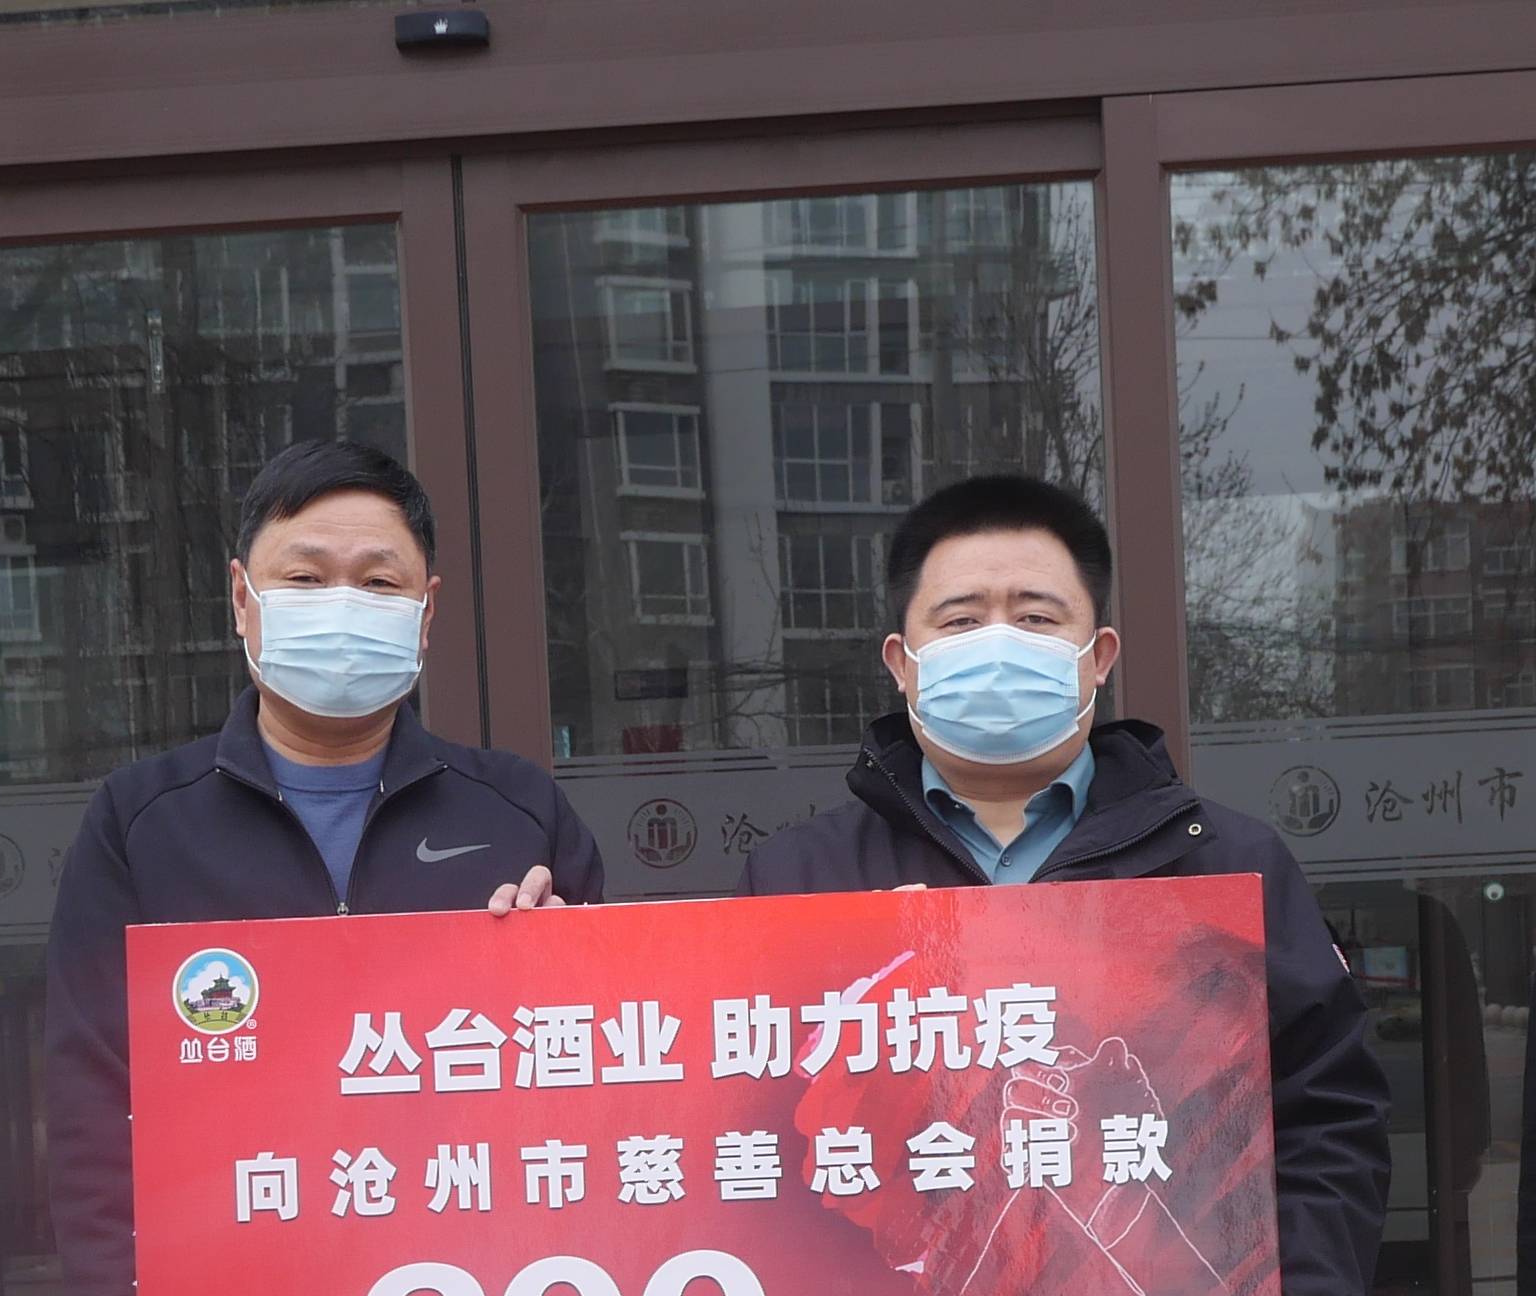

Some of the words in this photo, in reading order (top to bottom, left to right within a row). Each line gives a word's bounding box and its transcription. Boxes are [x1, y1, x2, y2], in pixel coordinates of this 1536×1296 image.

[180, 1035, 257, 1064] 丛台酒
[338, 1001, 684, 1095] 丛台酒业
[711, 983, 1060, 1080] 助力抗疫
[235, 1113, 1173, 1223] 向沧州市慈善总会捐款
